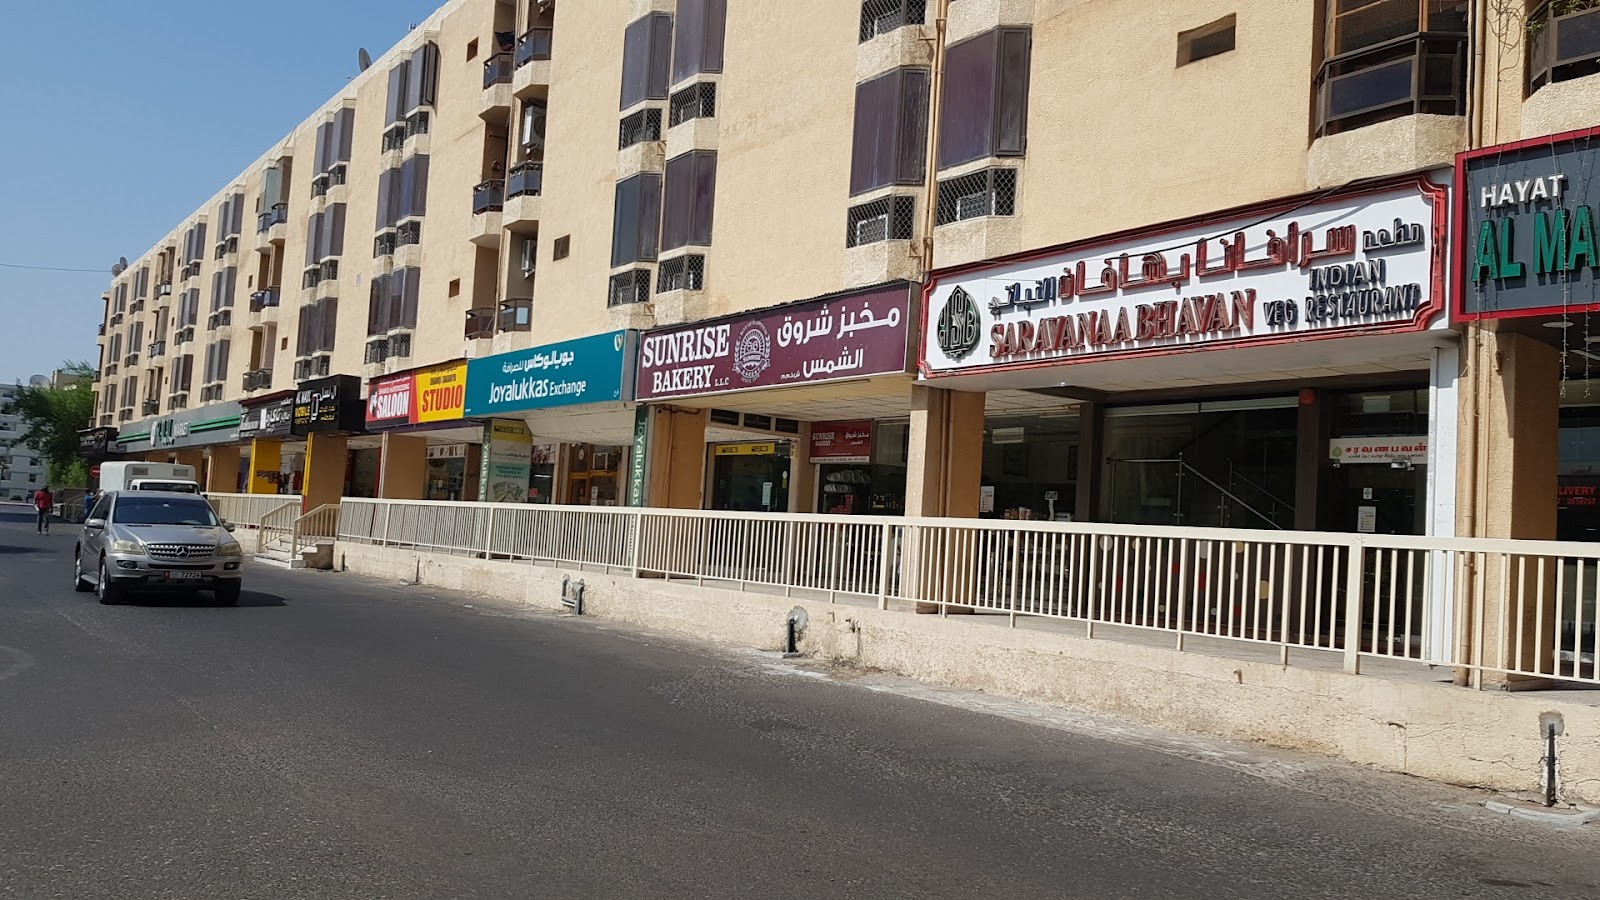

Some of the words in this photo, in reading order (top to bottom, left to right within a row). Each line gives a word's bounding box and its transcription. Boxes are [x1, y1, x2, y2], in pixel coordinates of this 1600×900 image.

[1480, 174, 1565, 208] HAYAT
[1471, 217, 1526, 282] AL
[1533, 205, 1600, 273] MA
[1308, 258, 1386, 291] INDIAN
[836, 302, 900, 340] مخبز
[1263, 298, 1299, 326] VEG
[1305, 283, 1422, 322] RESTAURANT
[777, 304, 833, 348] شروق
[989, 304, 1134, 357] SARAVANAA
[1134, 288, 1257, 341] BHAVAN
[642, 323, 731, 369] SUNRISE
[802, 346, 864, 379] الشمس
[488, 376, 549, 404] Joyalukkas
[549, 380, 587, 397] Exchange
[652, 364, 715, 394] BAKERY
[376, 390, 410, 419] SALOON
[422, 384, 463, 413] STUDIO
[812, 432, 835, 440] SUNRISE
[632, 417, 649, 506] Joyalukkas
